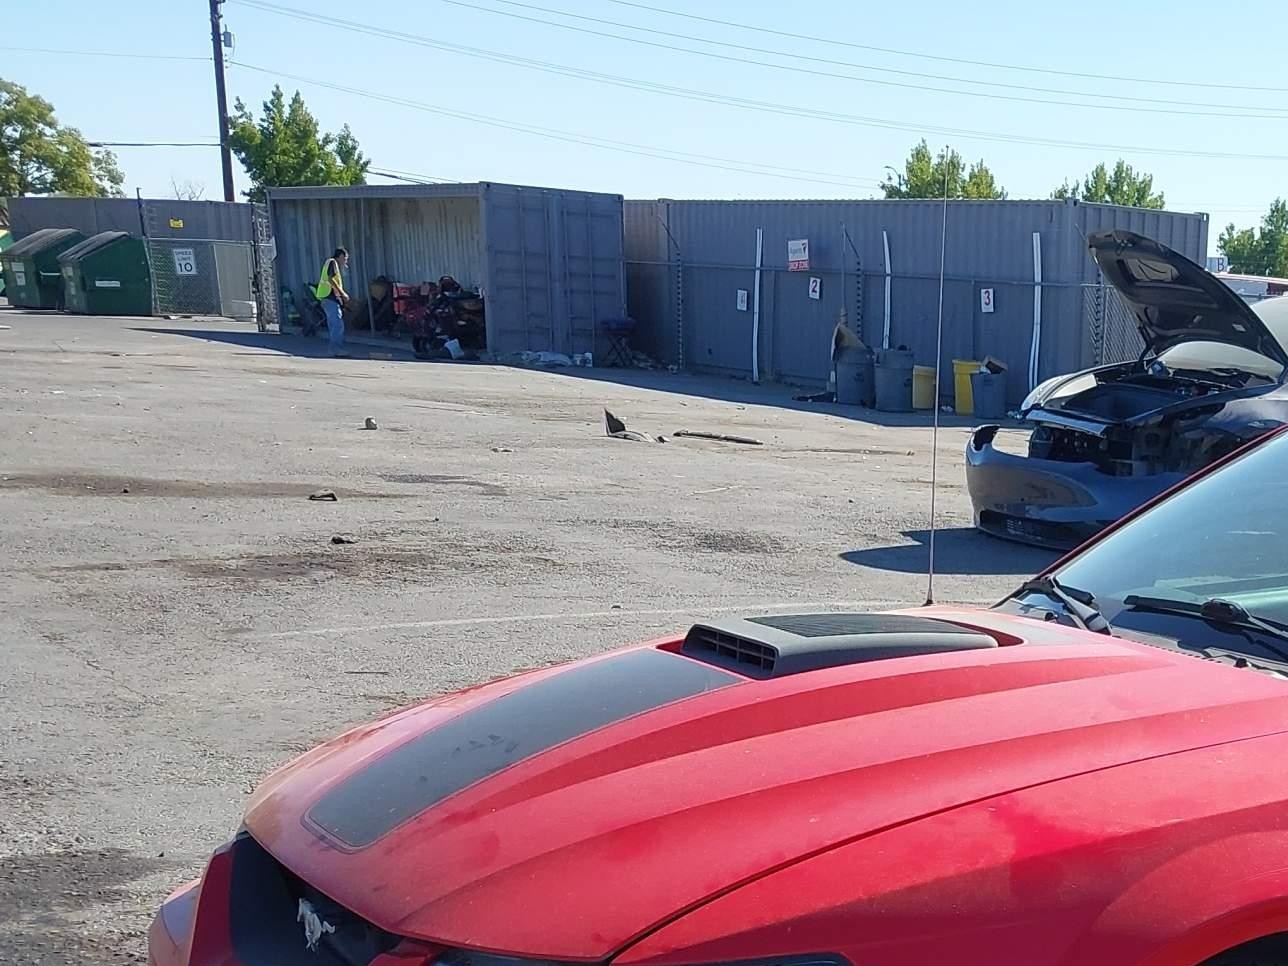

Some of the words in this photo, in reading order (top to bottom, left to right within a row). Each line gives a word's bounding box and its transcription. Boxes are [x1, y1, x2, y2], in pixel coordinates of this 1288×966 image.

[178, 262, 193, 272] 10
[1217, 257, 1225, 271] B
[811, 279, 818, 293] 2
[984, 290, 991, 305] 3
